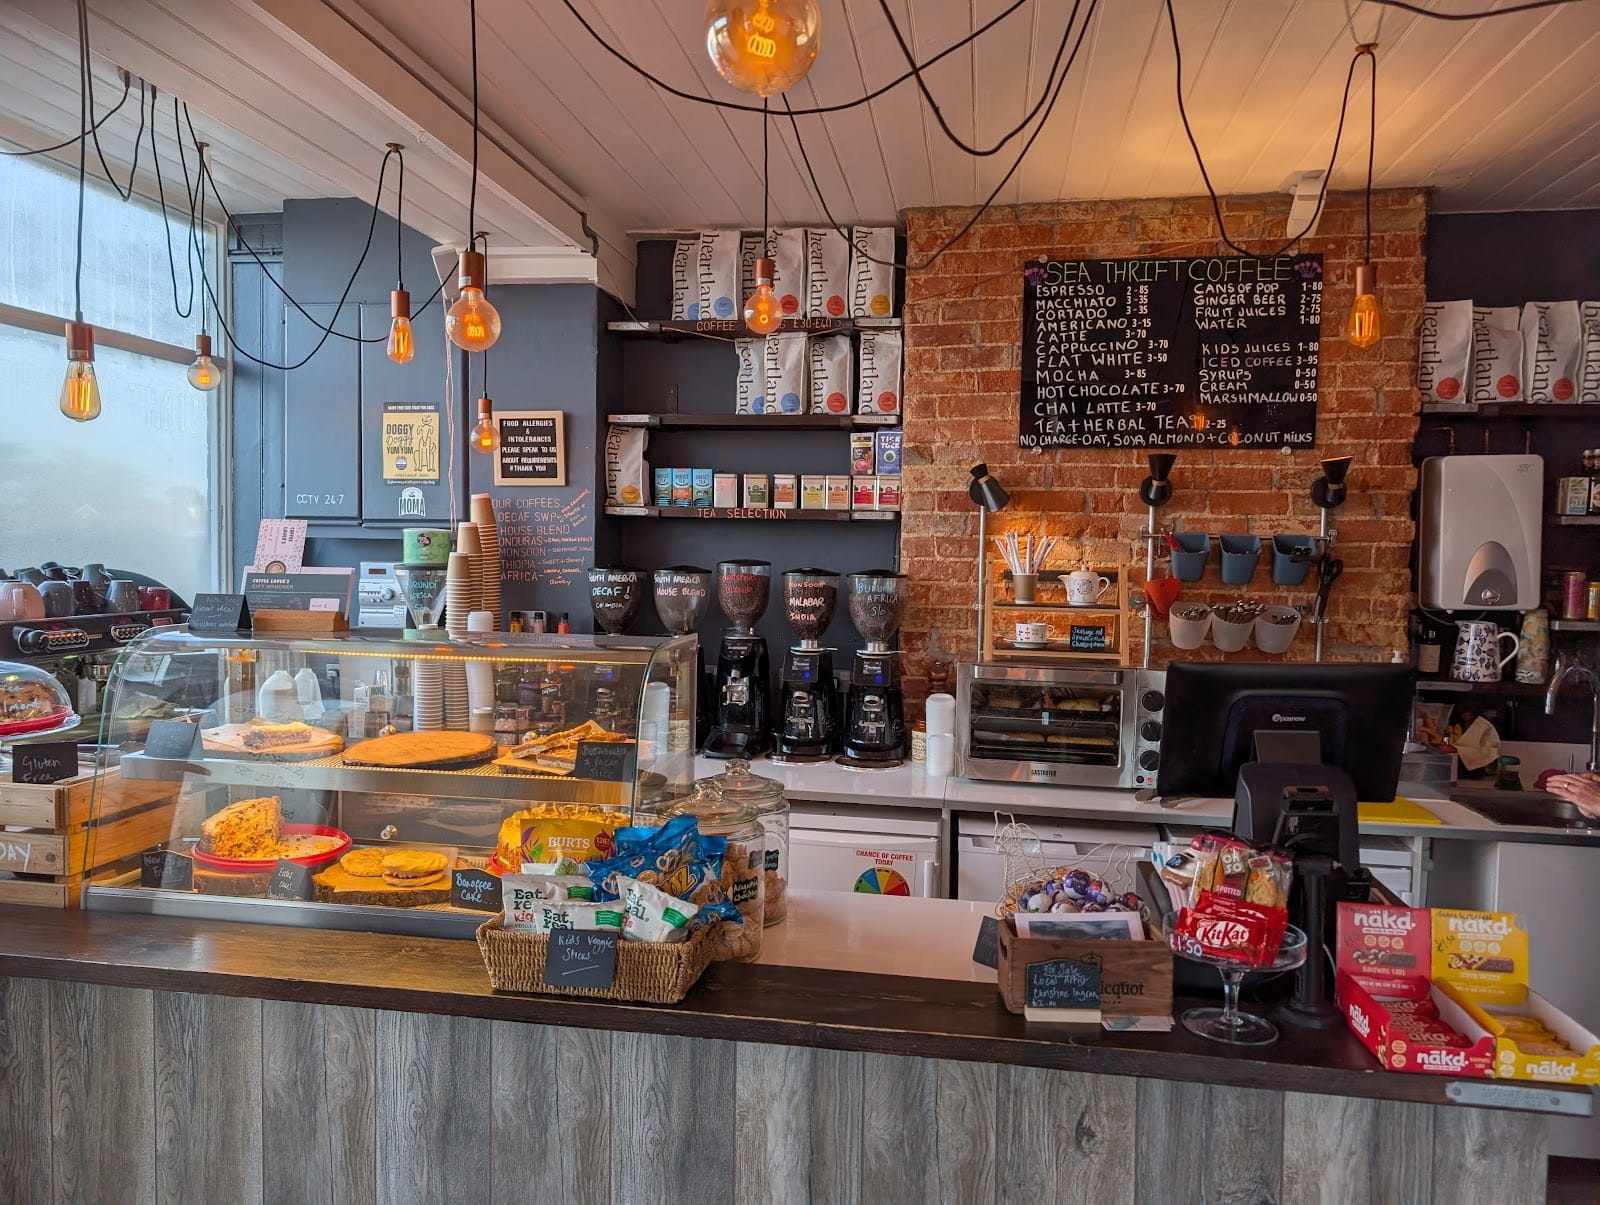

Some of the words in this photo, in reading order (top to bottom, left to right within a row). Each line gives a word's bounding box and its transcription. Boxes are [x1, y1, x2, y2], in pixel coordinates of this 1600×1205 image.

[700, 232, 719, 321] heartland
[854, 230, 873, 318] heartland
[1045, 262, 1091, 285] SEA
[1102, 260, 1188, 282] THRIFT
[1189, 258, 1290, 282] COFFEE
[1037, 285, 1105, 297] ESPRESSO
[1194, 283, 1234, 294] CANS
[1237, 283, 1252, 294] OF
[1257, 283, 1279, 293] POP
[1036, 297, 1116, 309] MACCHIATO
[1194, 294, 1246, 305] GINGER
[1254, 294, 1286, 305] BEER
[1036, 308, 1107, 321] CORTADO
[1195, 307, 1232, 318] FRUIT
[1239, 306, 1286, 317] JUICES
[696, 322, 735, 331] COFFEE
[1037, 318, 1128, 331] AMERICANO
[1195, 318, 1247, 330] WATER
[1037, 330, 1087, 343] LATTE
[1036, 340, 1138, 355] CAPPUCCINO
[1202, 343, 1239, 355] KIDS
[1244, 342, 1290, 353] JUICES
[1532, 304, 1557, 403] heartland
[1037, 355, 1081, 367] FLAT
[1091, 352, 1143, 366] WHITE
[1202, 356, 1240, 368] ICED
[1245, 355, 1293, 367] COFFEE
[1473, 310, 1499, 402] heartland
[862, 332, 879, 414] heartland
[1036, 369, 1099, 384] MOCHA
[1199, 369, 1252, 381] SYRUPS
[1037, 386, 1063, 400] HOT
[1069, 383, 1158, 397] CHOCOLATE
[1200, 381, 1248, 392] CREAM
[1201, 393, 1298, 404] MARSHMALLOW
[1034, 402, 1075, 416] CHAI
[1087, 401, 1131, 413] LATTE
[386, 424, 414, 434] DOGGY
[1020, 435, 1037, 446] NO
[1284, 431, 1312, 443] MILKS
[296, 494, 319, 504] CCTV
[492, 499, 511, 509] OUR
[516, 498, 561, 508] COFFEES
[399, 498, 425, 515] MOMA
[497, 512, 530, 522] DECAF
[697, 508, 716, 518] TEA
[727, 508, 786, 518] SELECTION
[500, 526, 533, 536] HOUSE
[537, 524, 570, 534] BLEND
[500, 548, 546, 557] MONSOON
[589, 572, 604, 582] SOUTH
[654, 573, 670, 584] SOUTH
[673, 575, 700, 584] AMERICA
[657, 587, 678, 596] HOUSE
[789, 597, 825, 607] MALABAR
[867, 594, 898, 603] AFRICA
[22, 755, 59, 771] Gluten
[548, 837, 590, 849] BURTS
[856, 850, 880, 858] CHANCE
[1222, 848, 1240, 863] OH
[1225, 864, 1242, 874] SO
[456, 873, 494, 892] Banoffee
[514, 889, 542, 900] Eat
[1216, 885, 1241, 896] SPOTTED
[543, 909, 569, 923] Eat
[1202, 923, 1248, 946] KitKat
[558, 935, 580, 946] Kids
[588, 935, 615, 954] Veggie
[1060, 963, 1081, 976] Sale
[1034, 974, 1057, 986] Local
